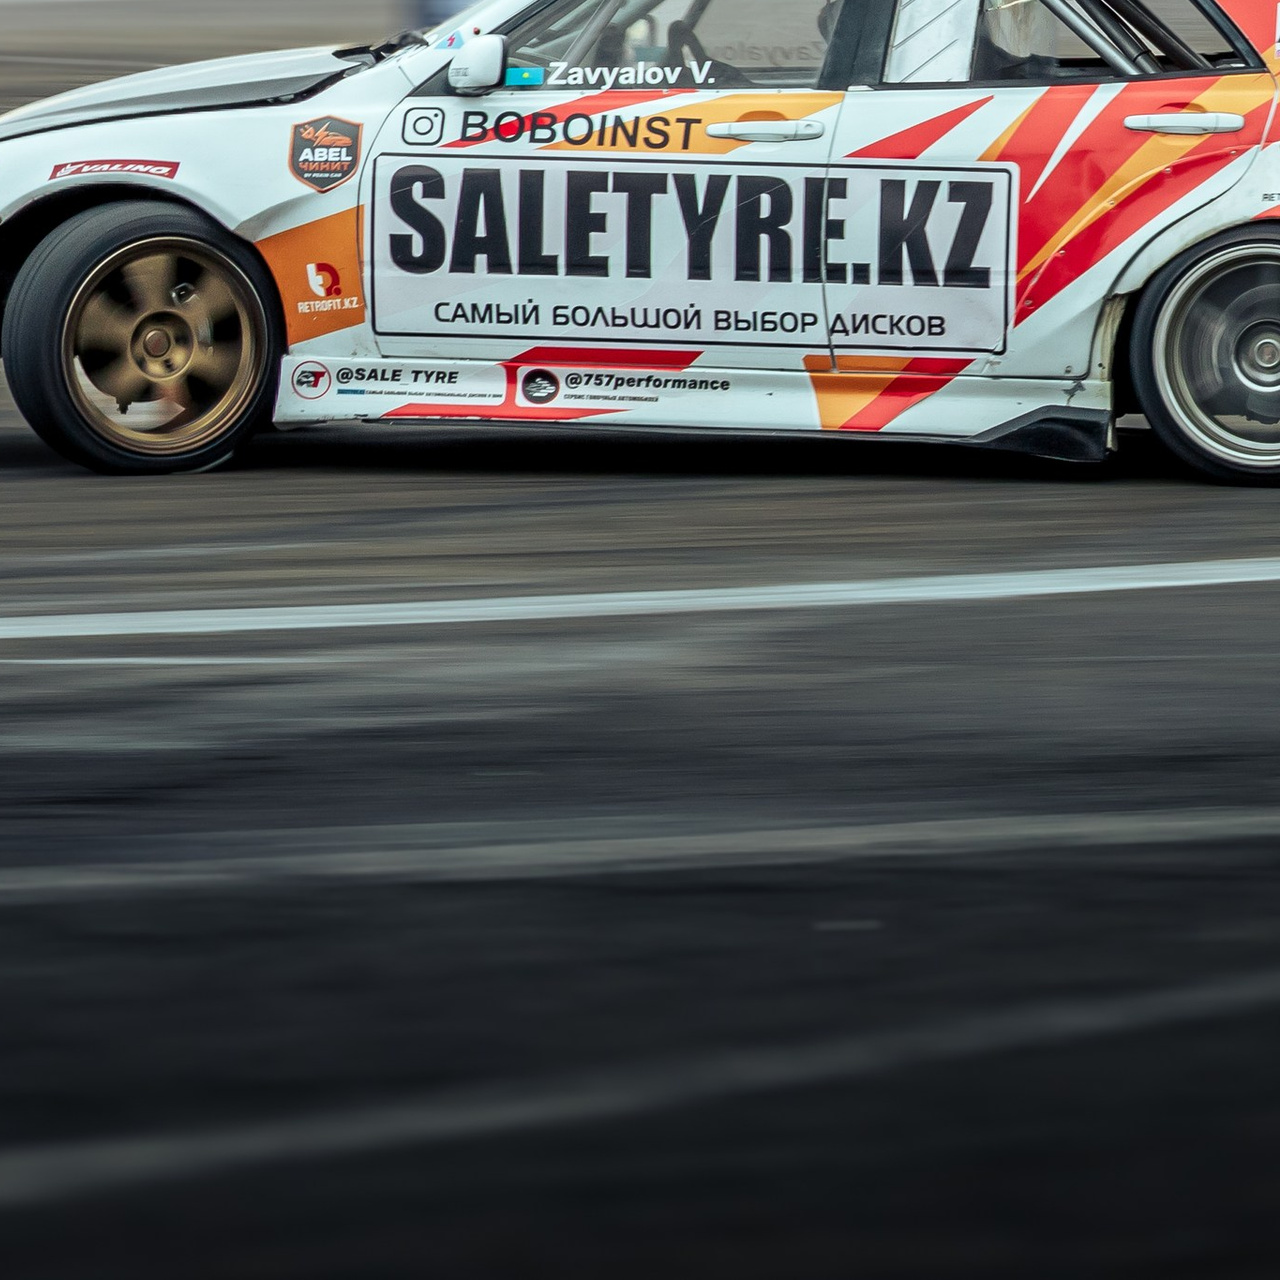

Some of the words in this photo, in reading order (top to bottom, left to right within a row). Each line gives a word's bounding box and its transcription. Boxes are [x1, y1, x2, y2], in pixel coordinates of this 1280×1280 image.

[547, 61, 682, 89] Zavyalov
[691, 61, 716, 84] V.
[460, 111, 703, 150] BOBOINST
[299, 148, 352, 161] ABEL
[81, 163, 173, 175] VALINO
[299, 162, 351, 171] ЧИНИТ
[389, 164, 994, 288] SALETYRE.KZ
[434, 299, 540, 324] САМЫЙ
[552, 303, 701, 329] БОЛЬШОЙ
[714, 310, 818, 334] ВЫБОР
[830, 313, 946, 337] ДИСКОВ
[564, 373, 730, 390] @757performance
